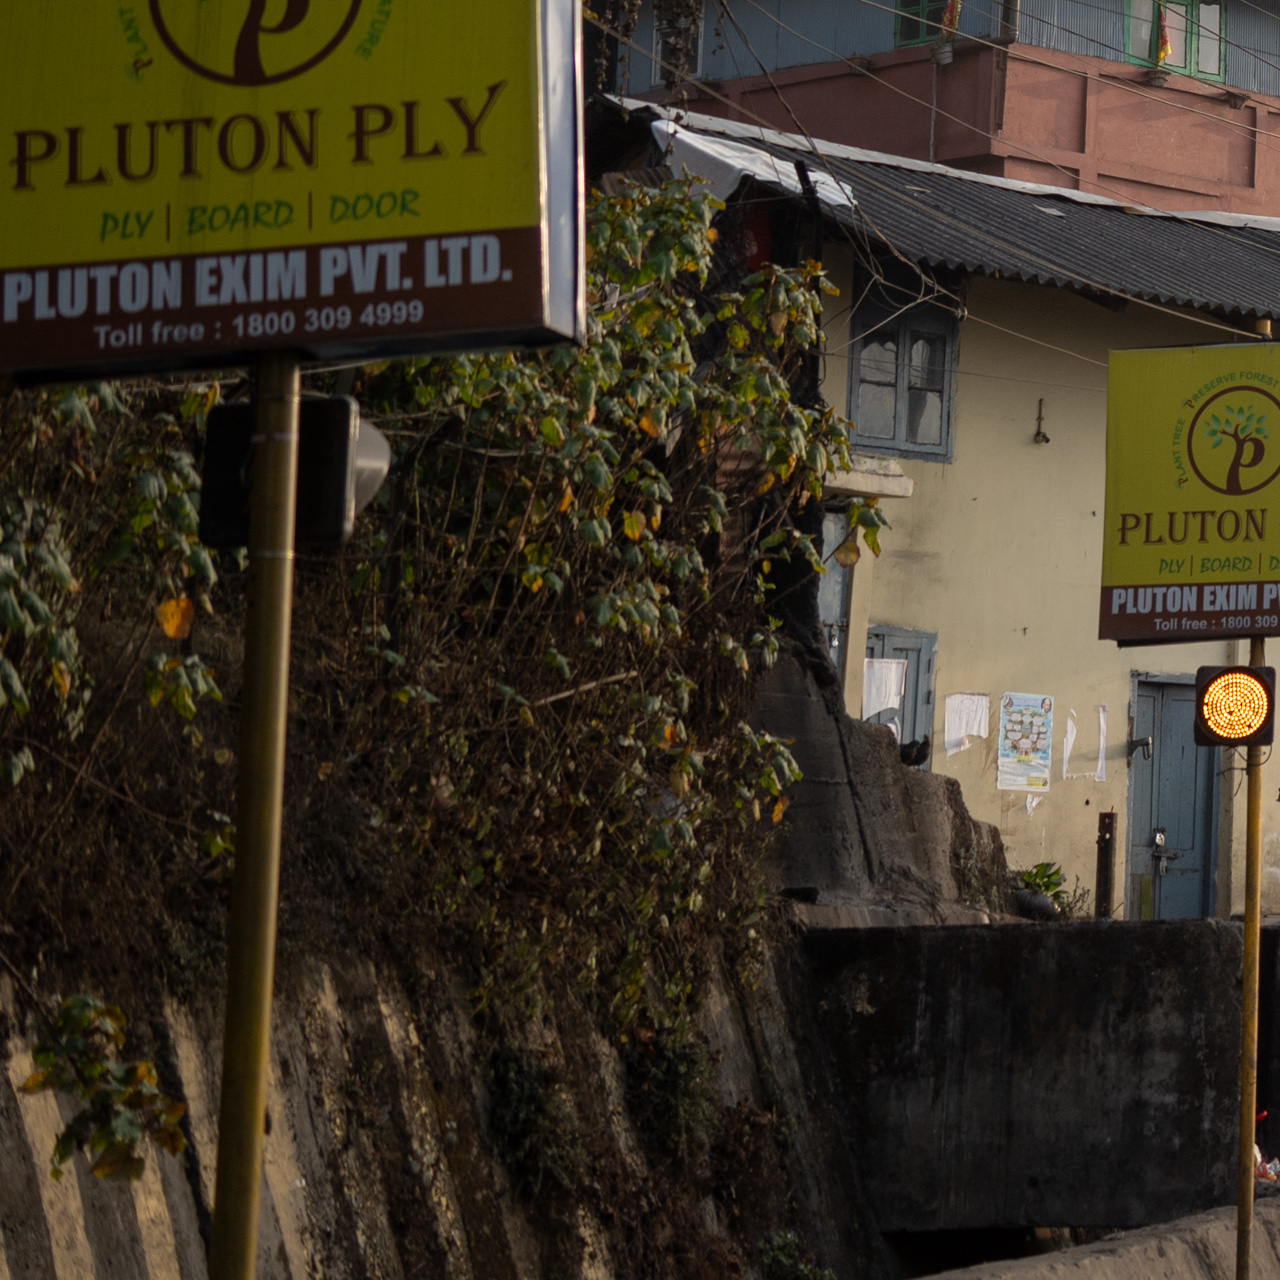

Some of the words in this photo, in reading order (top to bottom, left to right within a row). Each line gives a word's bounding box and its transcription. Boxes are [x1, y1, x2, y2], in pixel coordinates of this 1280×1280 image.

[118, 1, 154, 74] PLANT
[10, 108, 321, 191] PLUTON
[347, 79, 508, 166] PLY
[100, 209, 154, 243] PLY
[186, 199, 294, 236] BOARD
[328, 188, 420, 224] DOOR
[1, 261, 181, 321] PLUTON
[194, 251, 306, 307] EXIM
[320, 243, 412, 297] PVT.
[424, 236, 513, 287] LTD.
[94, 324, 143, 350] Toll
[152, 320, 204, 345] free
[231, 309, 295, 338] 1800
[304, 305, 352, 332] 309
[359, 299, 423, 327] 4999
[1186, 373, 1236, 409] PRESERVE
[1240, 372, 1280, 388] FOREST
[1173, 418, 1185, 446] TREE
[1172, 449, 1188, 486] PLANT
[1117, 509, 1267, 546] PLUTON
[1159, 558, 1184, 575] PLY
[1200, 557, 1252, 573] BOARD
[1112, 587, 1197, 614] PLUTON
[1203, 584, 1257, 611] EXIM
[1154, 618, 1178, 631] Toll
[1182, 618, 1207, 630] free
[1221, 617, 1250, 628] 1800
[1255, 616, 1278, 628] 309
